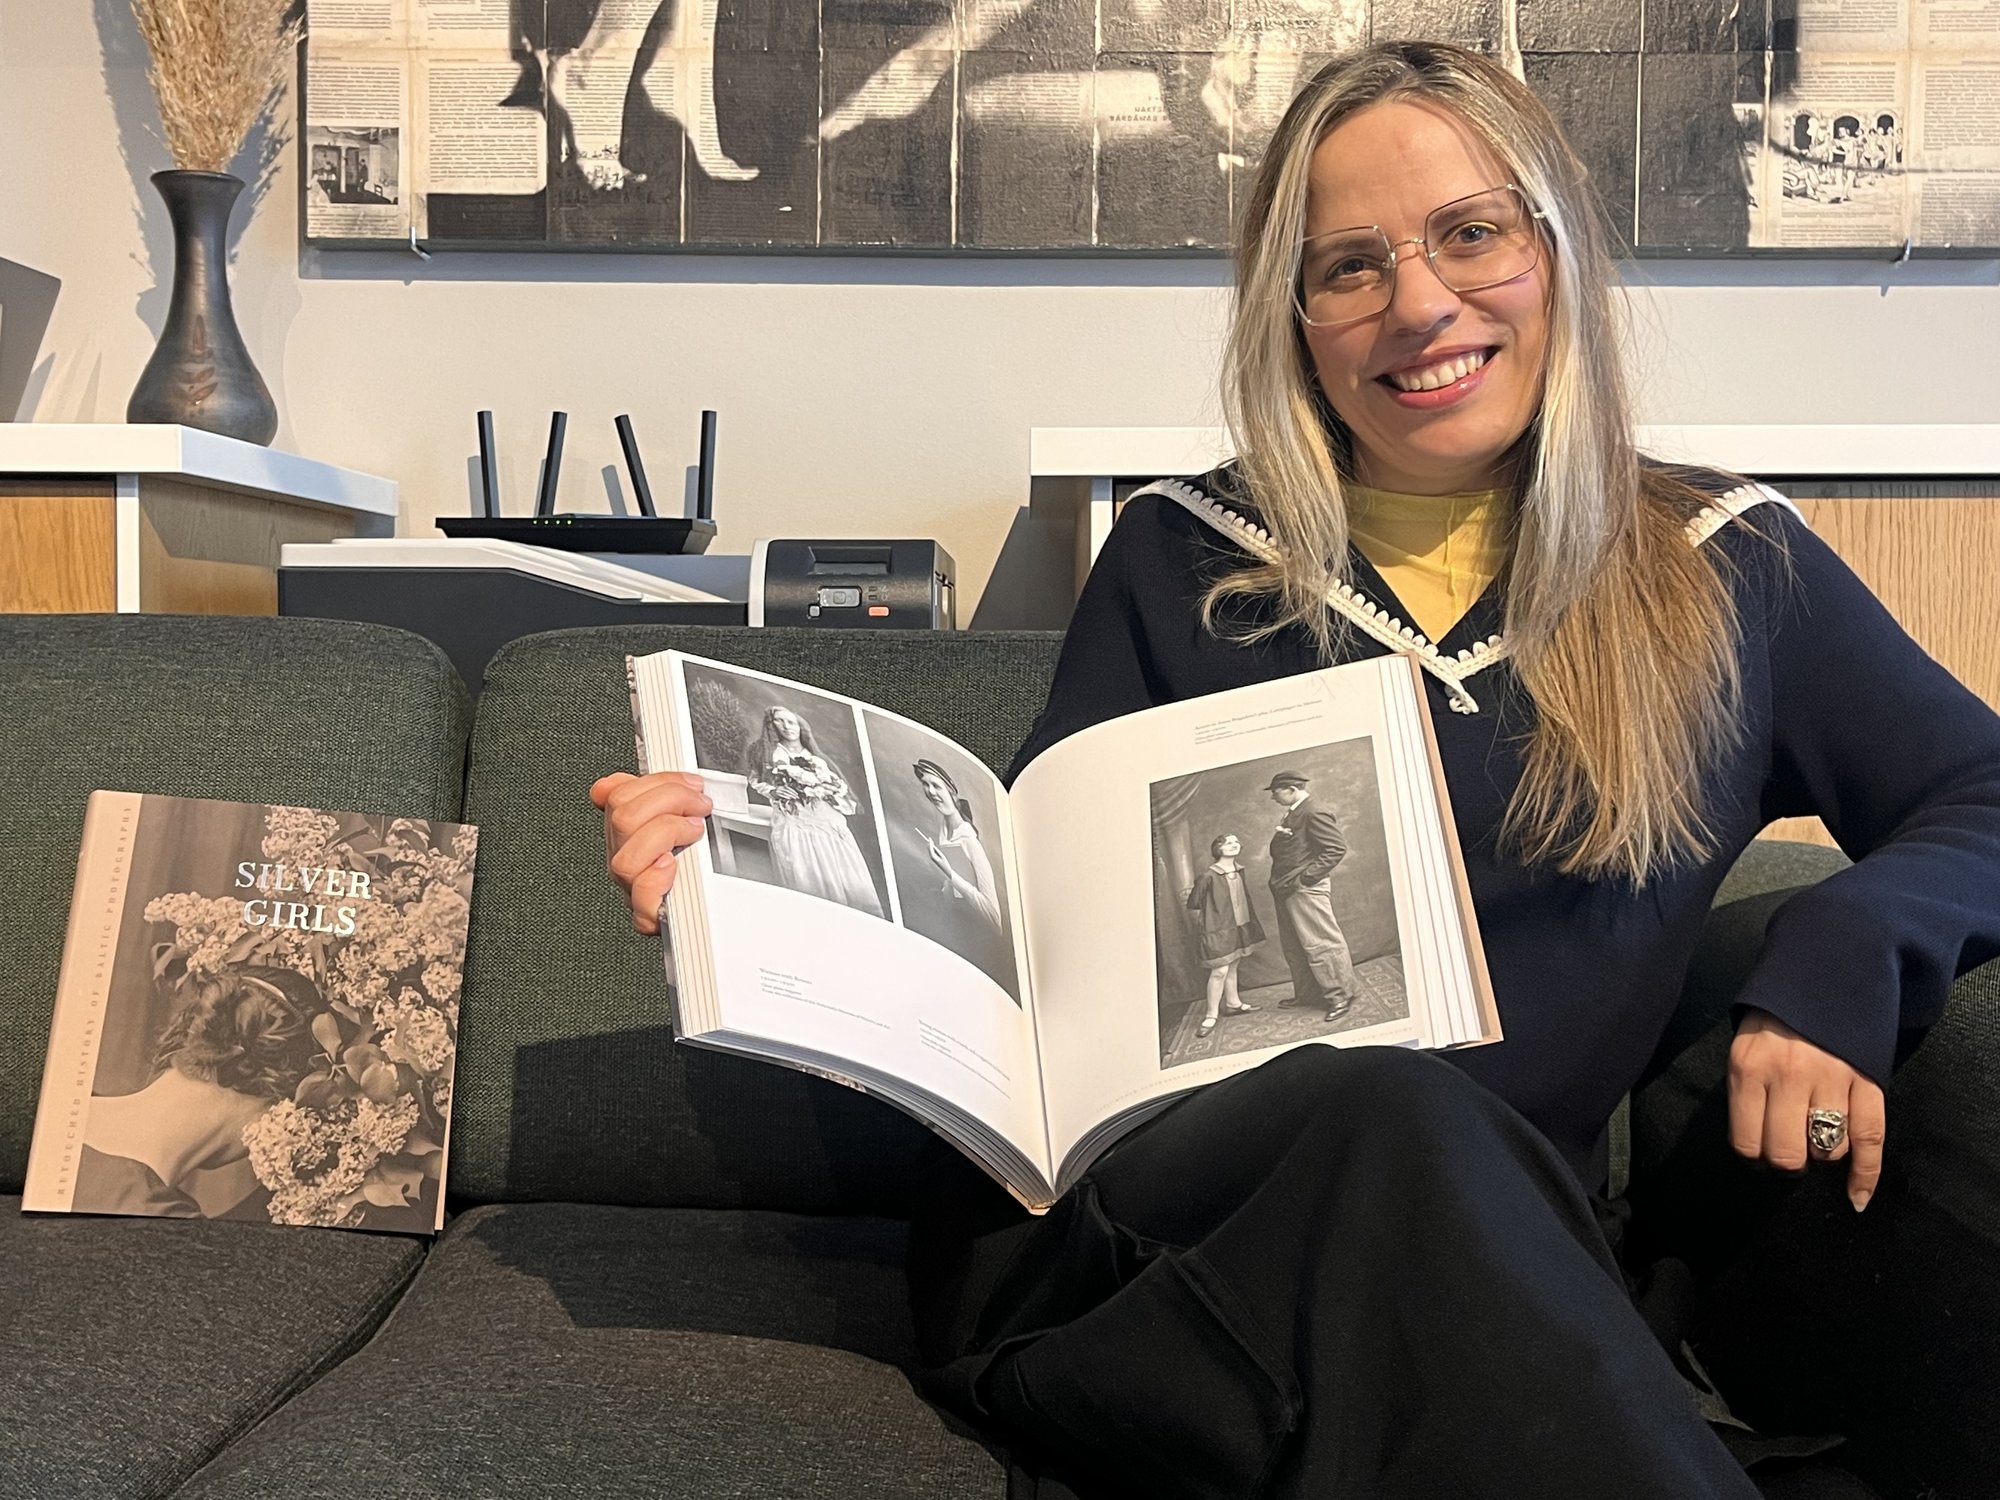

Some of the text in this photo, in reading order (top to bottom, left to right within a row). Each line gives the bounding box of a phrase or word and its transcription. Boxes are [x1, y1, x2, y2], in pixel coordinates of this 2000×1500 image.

[235, 861, 372, 900] SILVER
[243, 899, 357, 937] GIRLS
[57, 807, 132, 1195] RETOUCHED HISTORY OF BALTIC PHOTOGRAPHY
